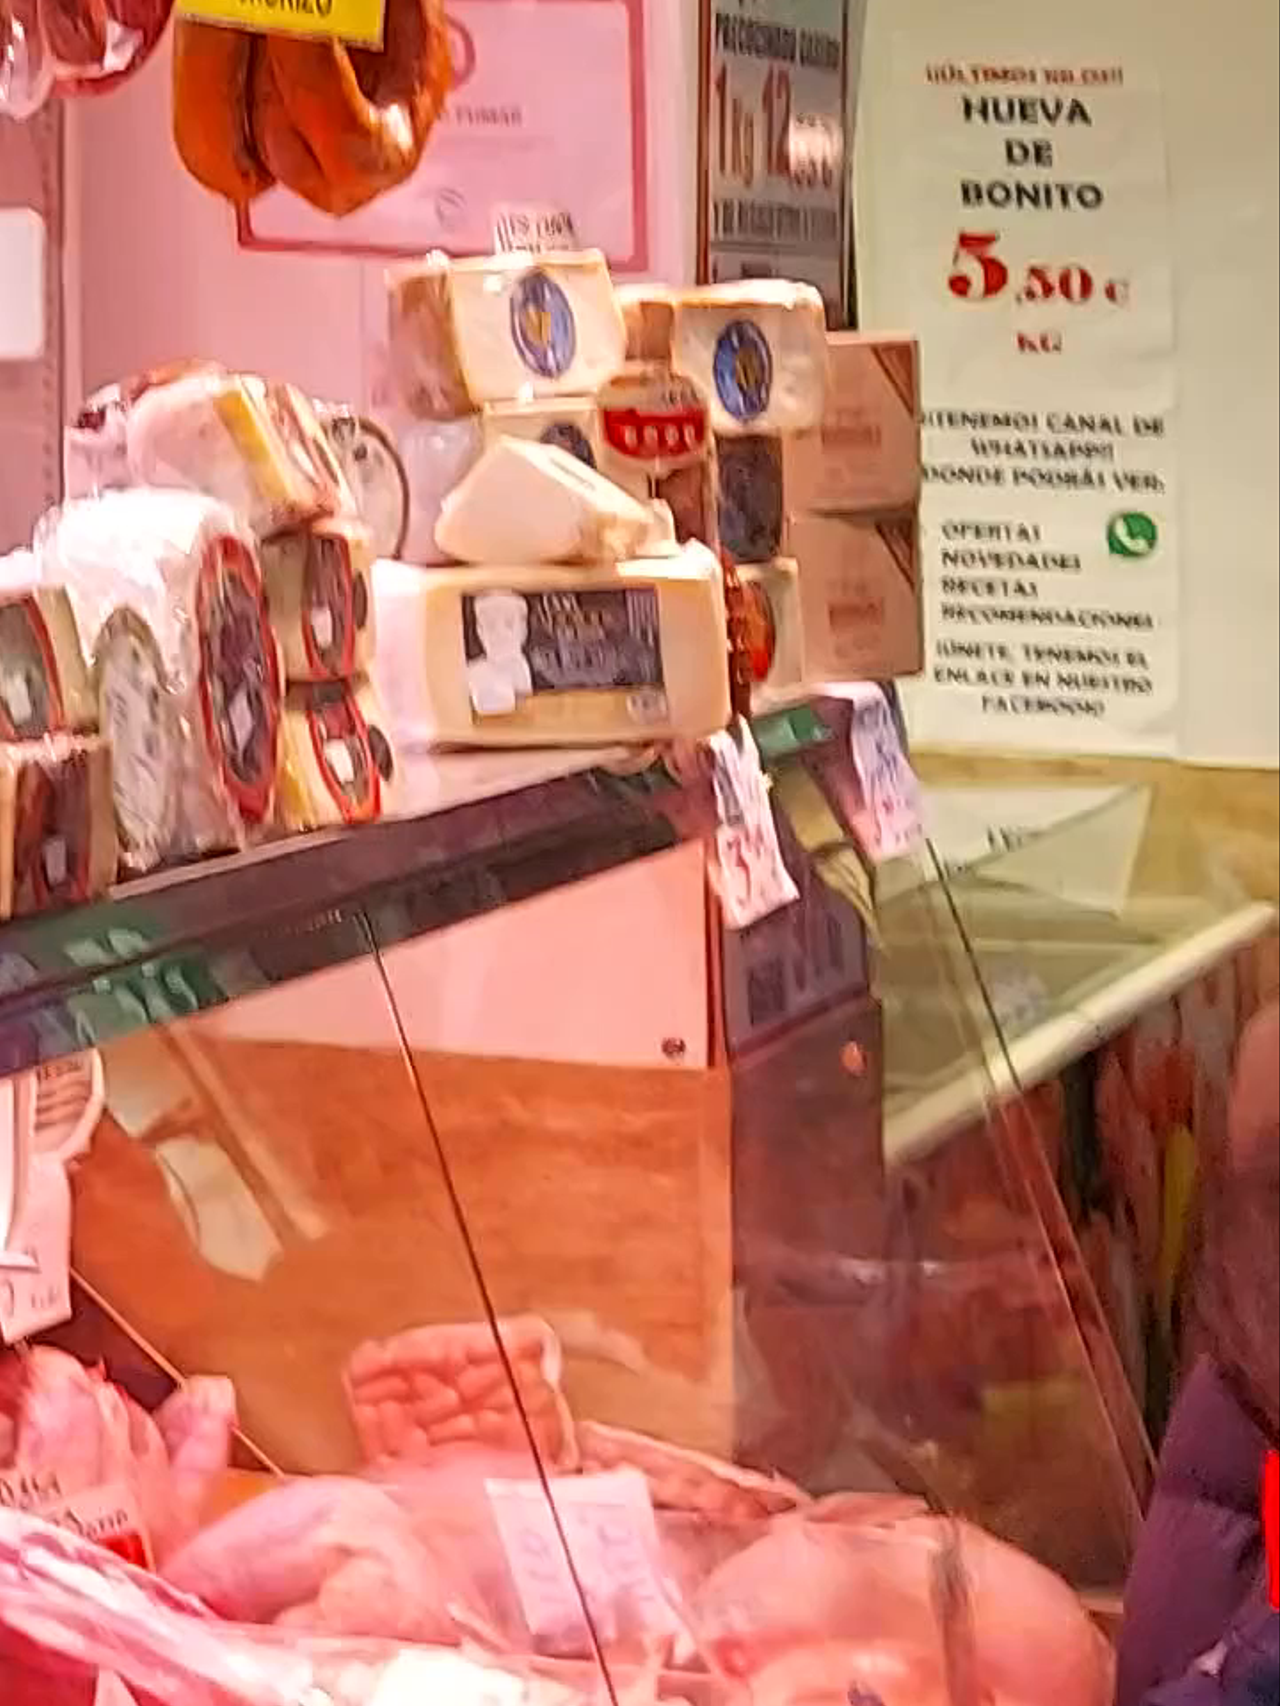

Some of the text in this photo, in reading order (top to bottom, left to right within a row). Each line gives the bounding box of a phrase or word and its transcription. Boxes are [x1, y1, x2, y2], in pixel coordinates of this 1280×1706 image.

[960, 95, 1093, 127] HUEVA
[1004, 137, 1054, 168] DE
[959, 179, 1105, 211] BONITO
